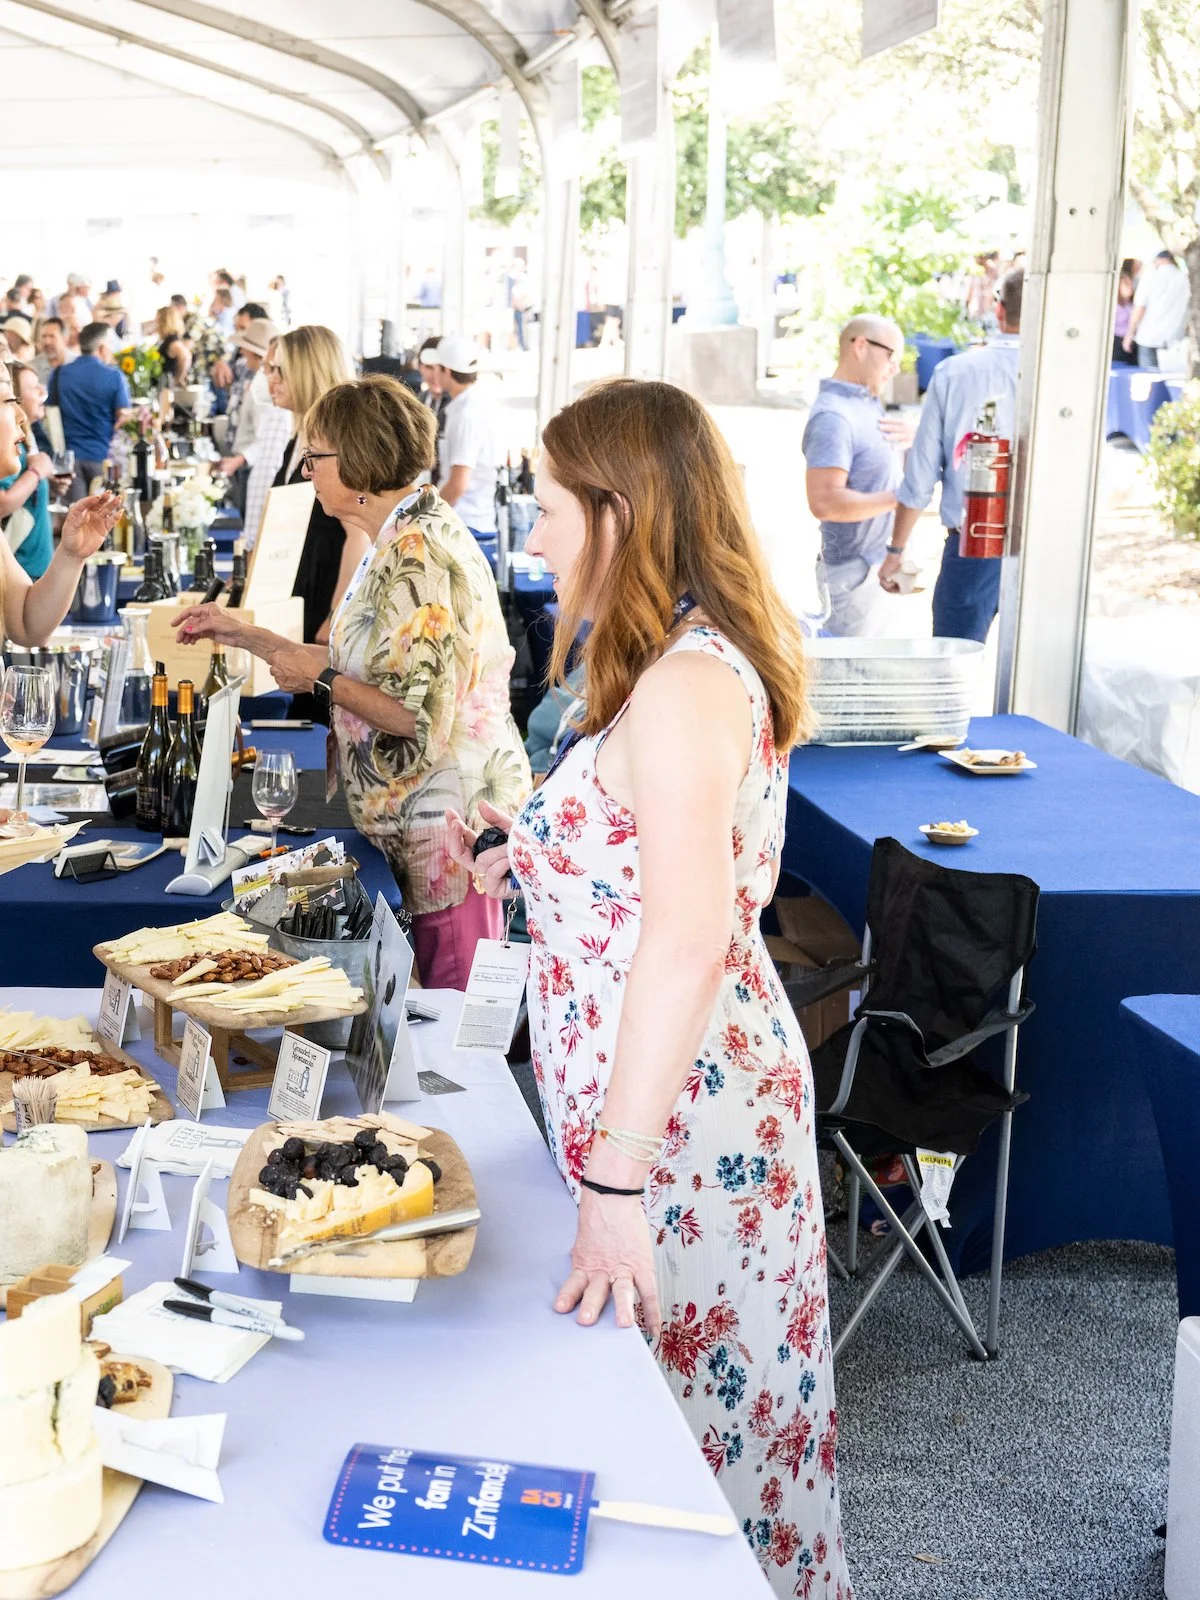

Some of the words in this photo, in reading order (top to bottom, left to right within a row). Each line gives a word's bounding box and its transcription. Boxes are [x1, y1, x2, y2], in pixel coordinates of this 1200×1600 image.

[378, 1449, 413, 1466] the
[424, 1465, 458, 1479] in
[376, 1465, 409, 1494] put
[414, 1480, 454, 1510] fan
[357, 1495, 396, 1529] We
